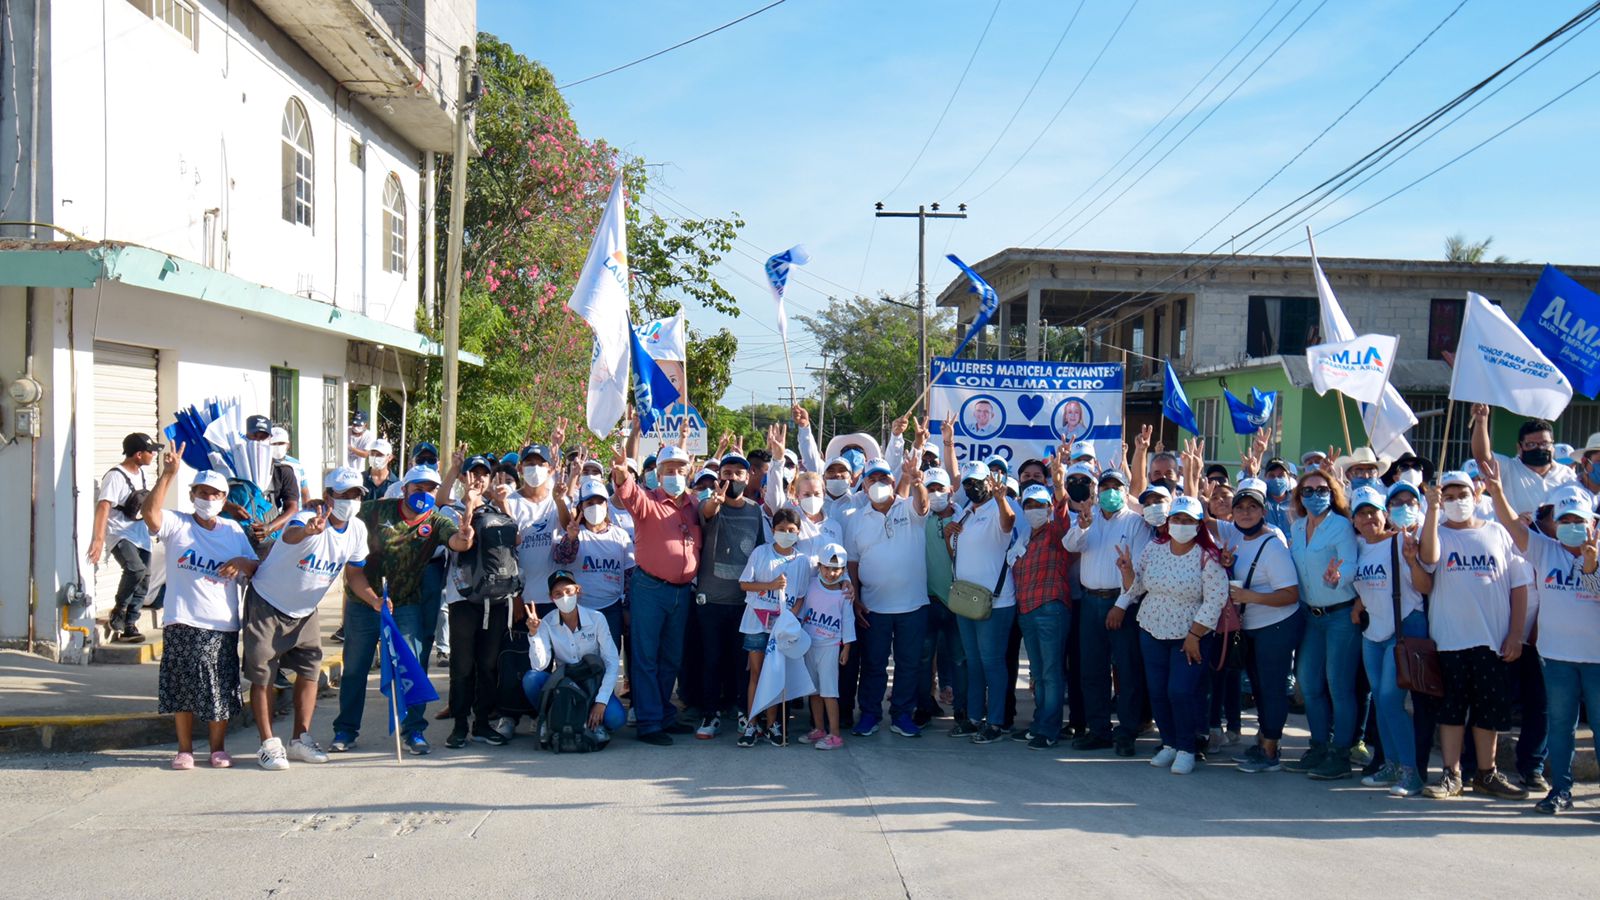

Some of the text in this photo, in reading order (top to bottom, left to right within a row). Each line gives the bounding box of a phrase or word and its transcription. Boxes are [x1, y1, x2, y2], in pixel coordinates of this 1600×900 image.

[1538, 318, 1559, 336] LAURA
[1503, 352, 1526, 365] PARA
[996, 364, 1053, 378] MARICELA
[955, 375, 1104, 390] CON ALMA Y CIRO
[954, 443, 1013, 462] CIRO
[177, 548, 224, 571] ALM
[1447, 552, 1496, 567] ALMA
[1357, 564, 1386, 576] LMA
[1545, 583, 1567, 592] LAURA
